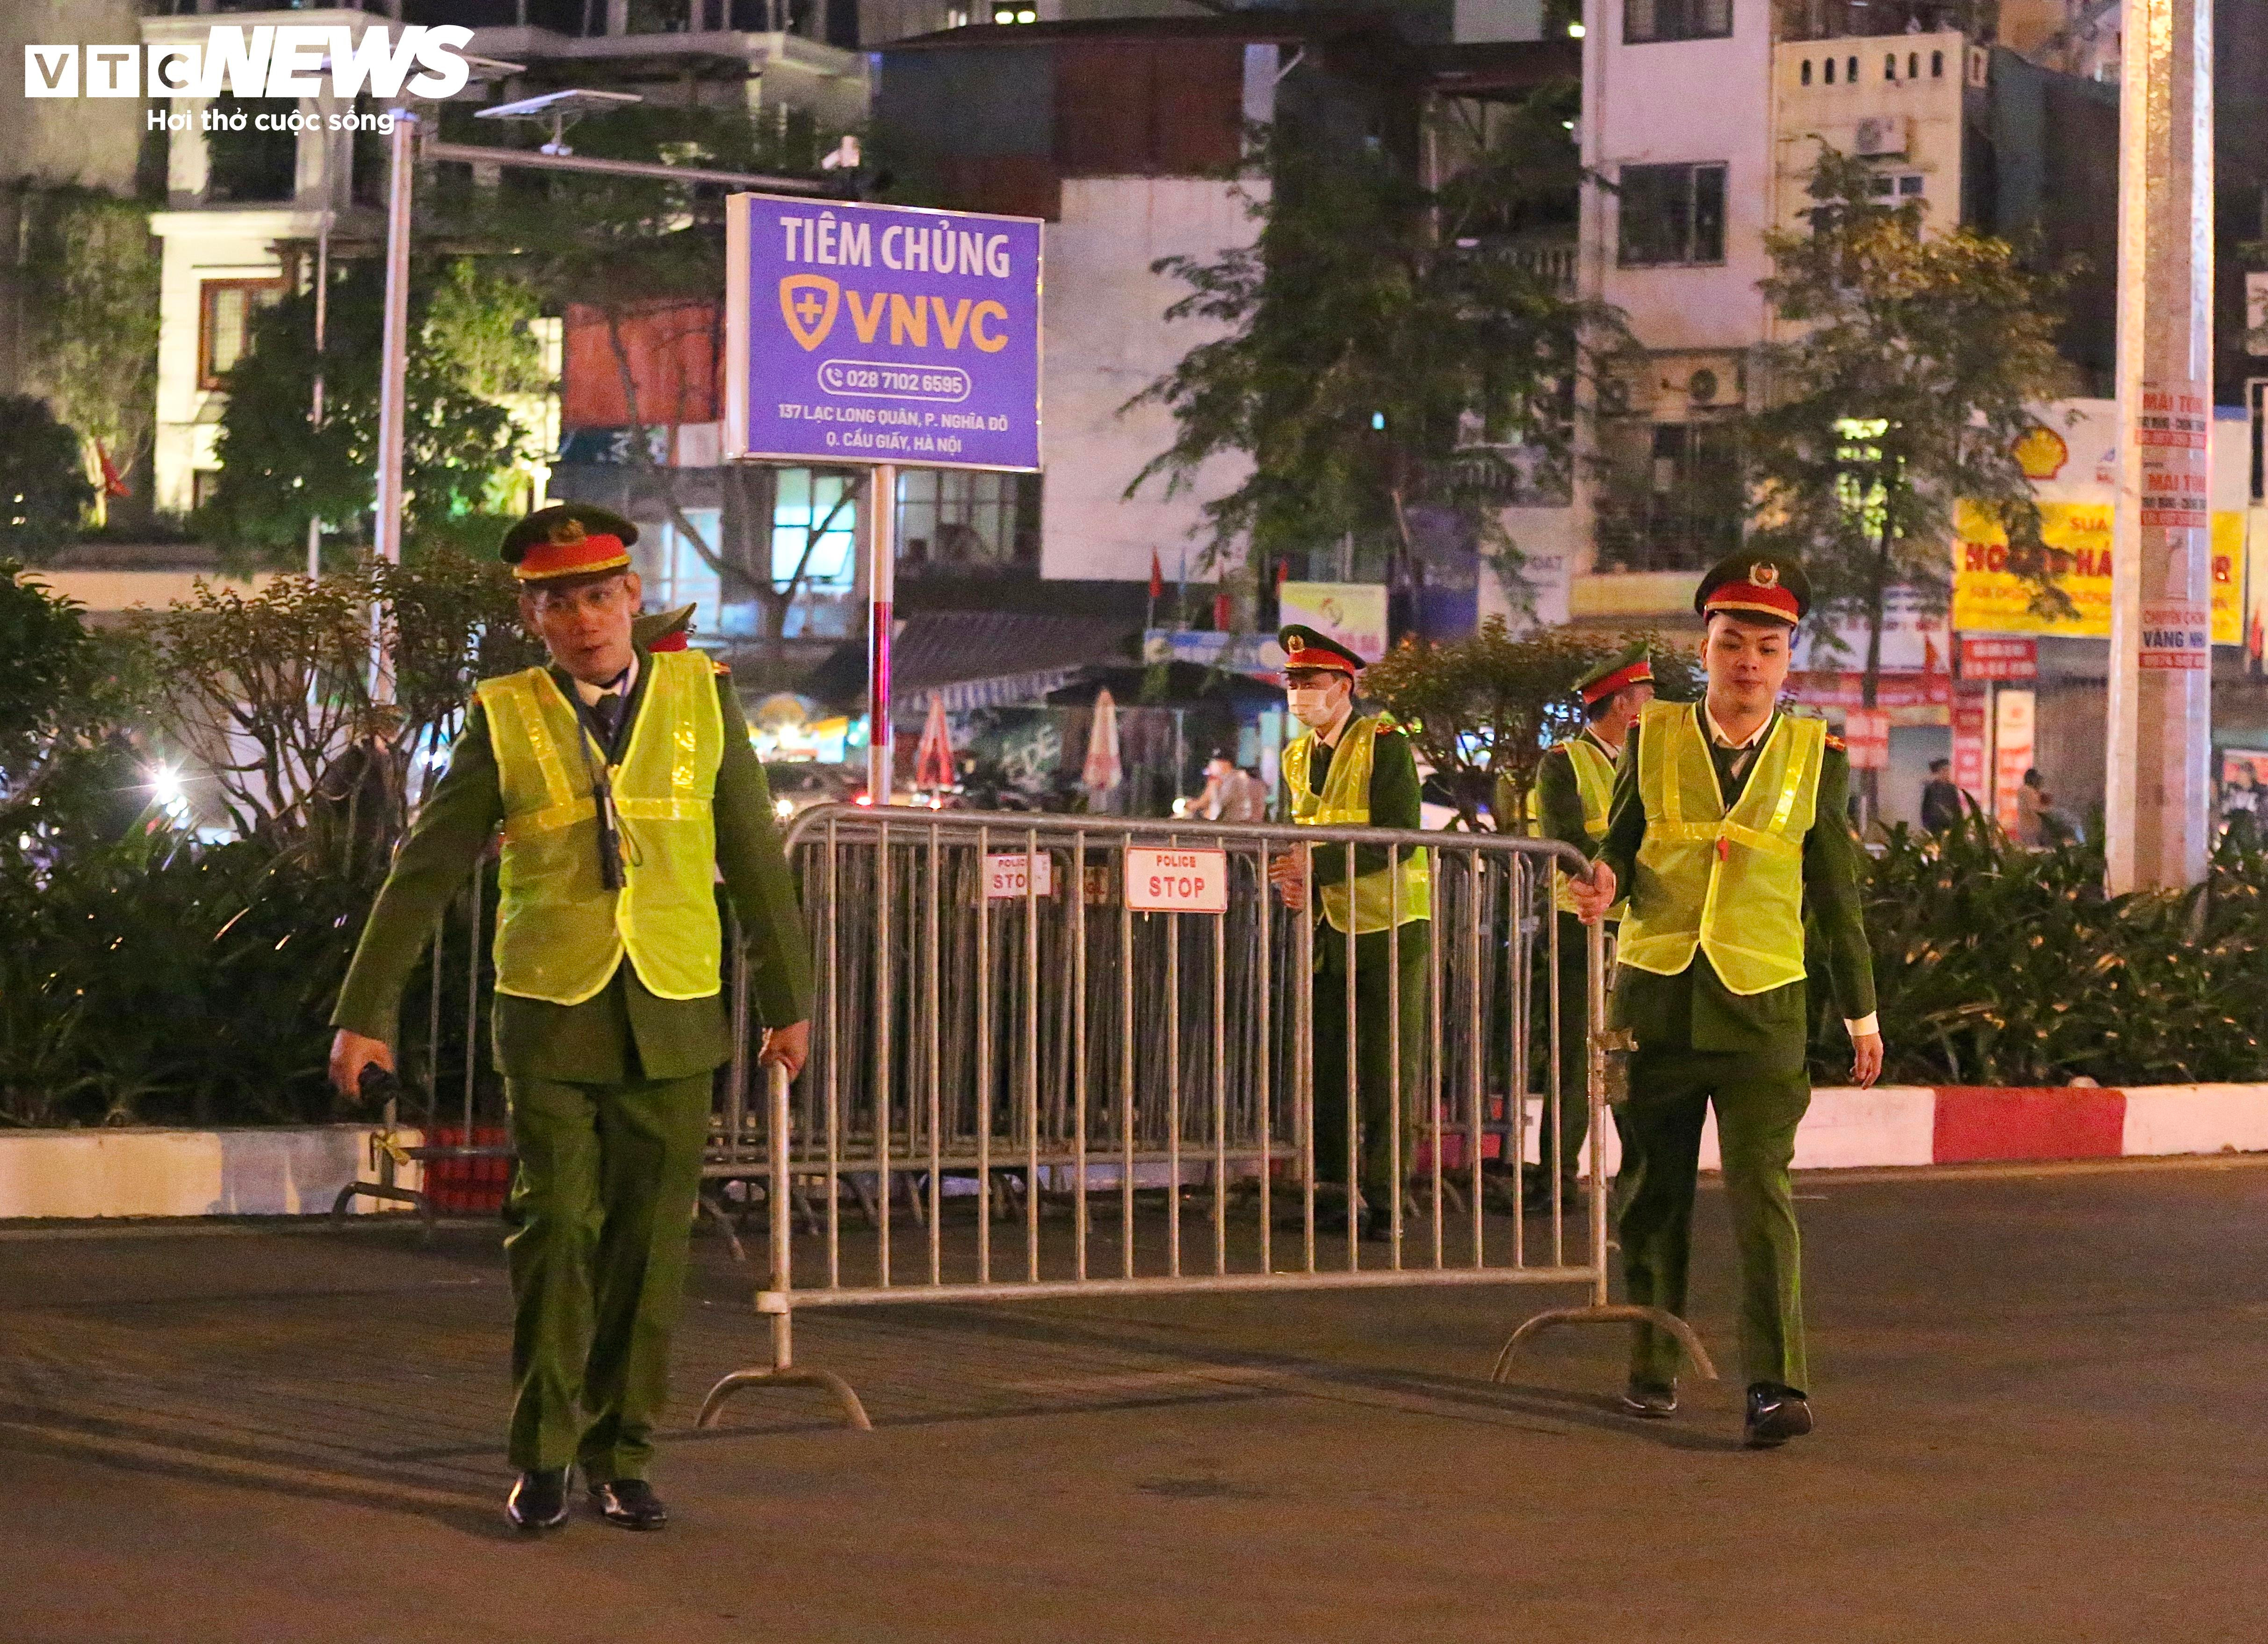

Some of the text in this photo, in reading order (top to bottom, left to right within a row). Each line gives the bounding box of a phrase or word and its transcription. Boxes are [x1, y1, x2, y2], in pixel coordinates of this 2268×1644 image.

[780, 210, 1010, 278] TIÊM CHỦNG
[845, 289, 1009, 353] VNVC
[846, 370, 963, 394] 028 7102 6595
[779, 404, 801, 419] 137
[803, 405, 834, 424] LẠC
[836, 407, 876, 423] LONG
[998, 858, 1026, 867] POLIC
[1156, 855, 1196, 868] POLICE
[993, 873, 1026, 889] STO
[1149, 876, 1205, 898] STOP
